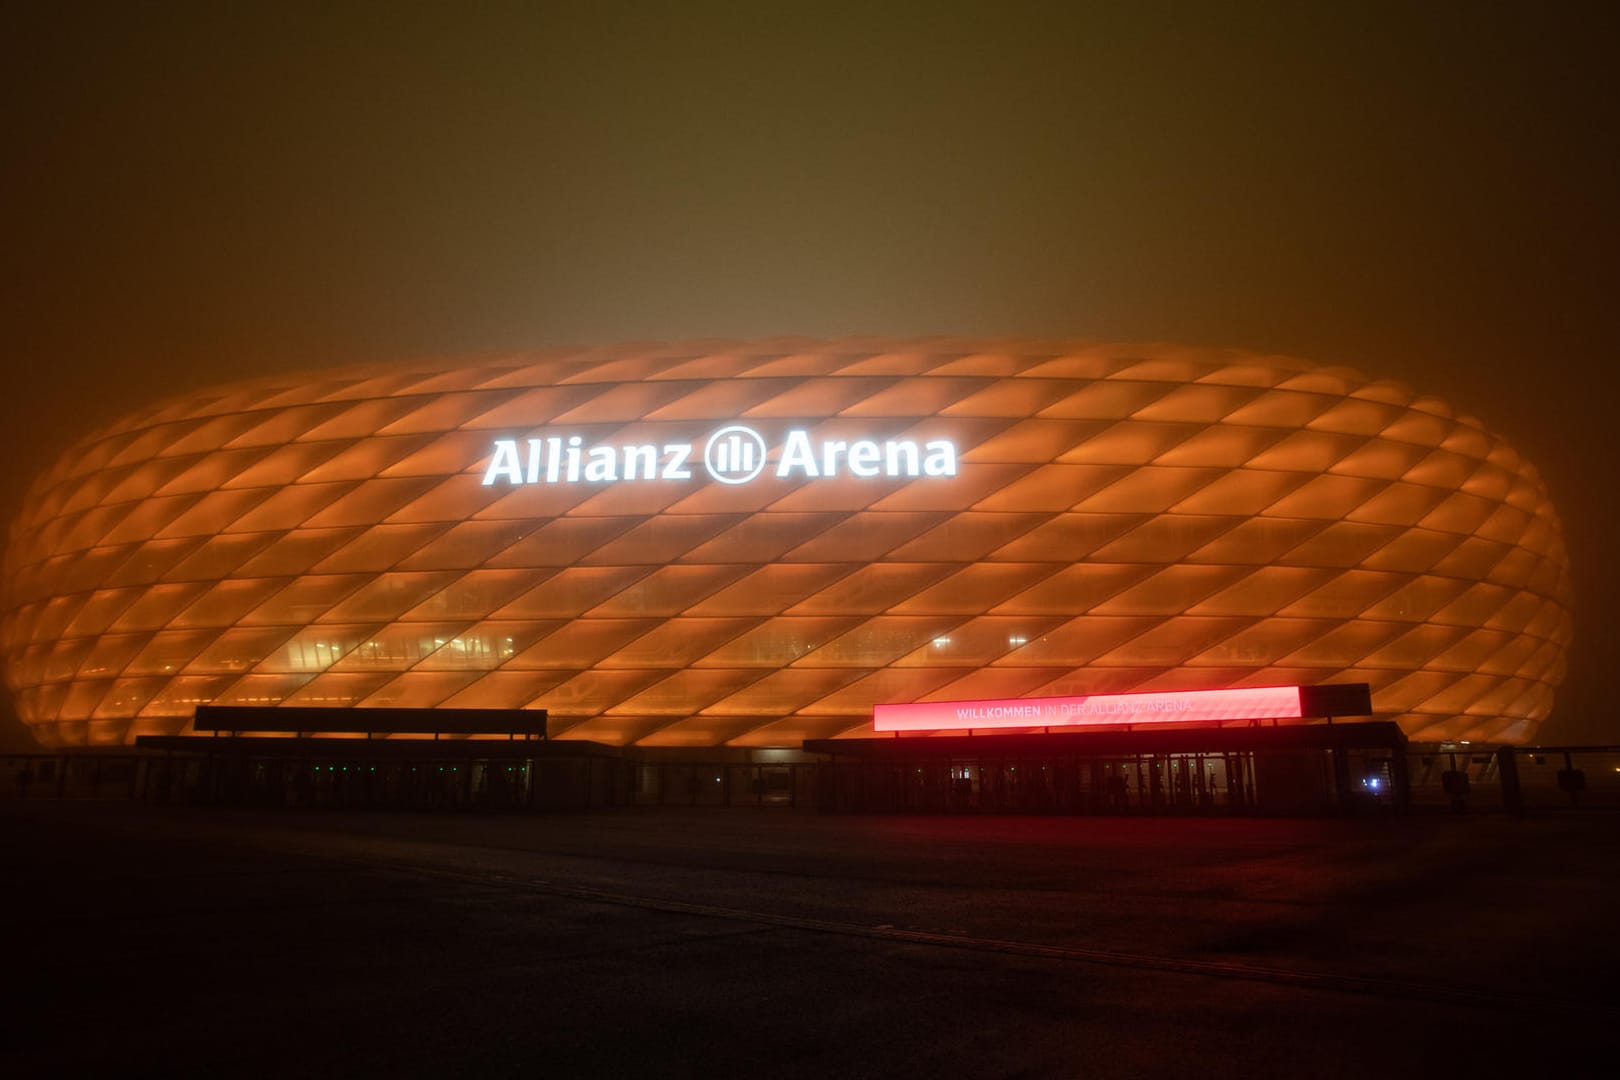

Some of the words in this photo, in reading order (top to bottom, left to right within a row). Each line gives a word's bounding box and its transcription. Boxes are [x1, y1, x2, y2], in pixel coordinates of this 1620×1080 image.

[482, 436, 691, 486] Allianz
[776, 430, 957, 478] Arena
[956, 706, 1041, 720] WILLKOMMEN
[1045, 705, 1057, 717] IN
[1061, 703, 1086, 716] DER
[1090, 702, 1141, 715] ALLIANZ
[1145, 700, 1193, 713] ARENA
